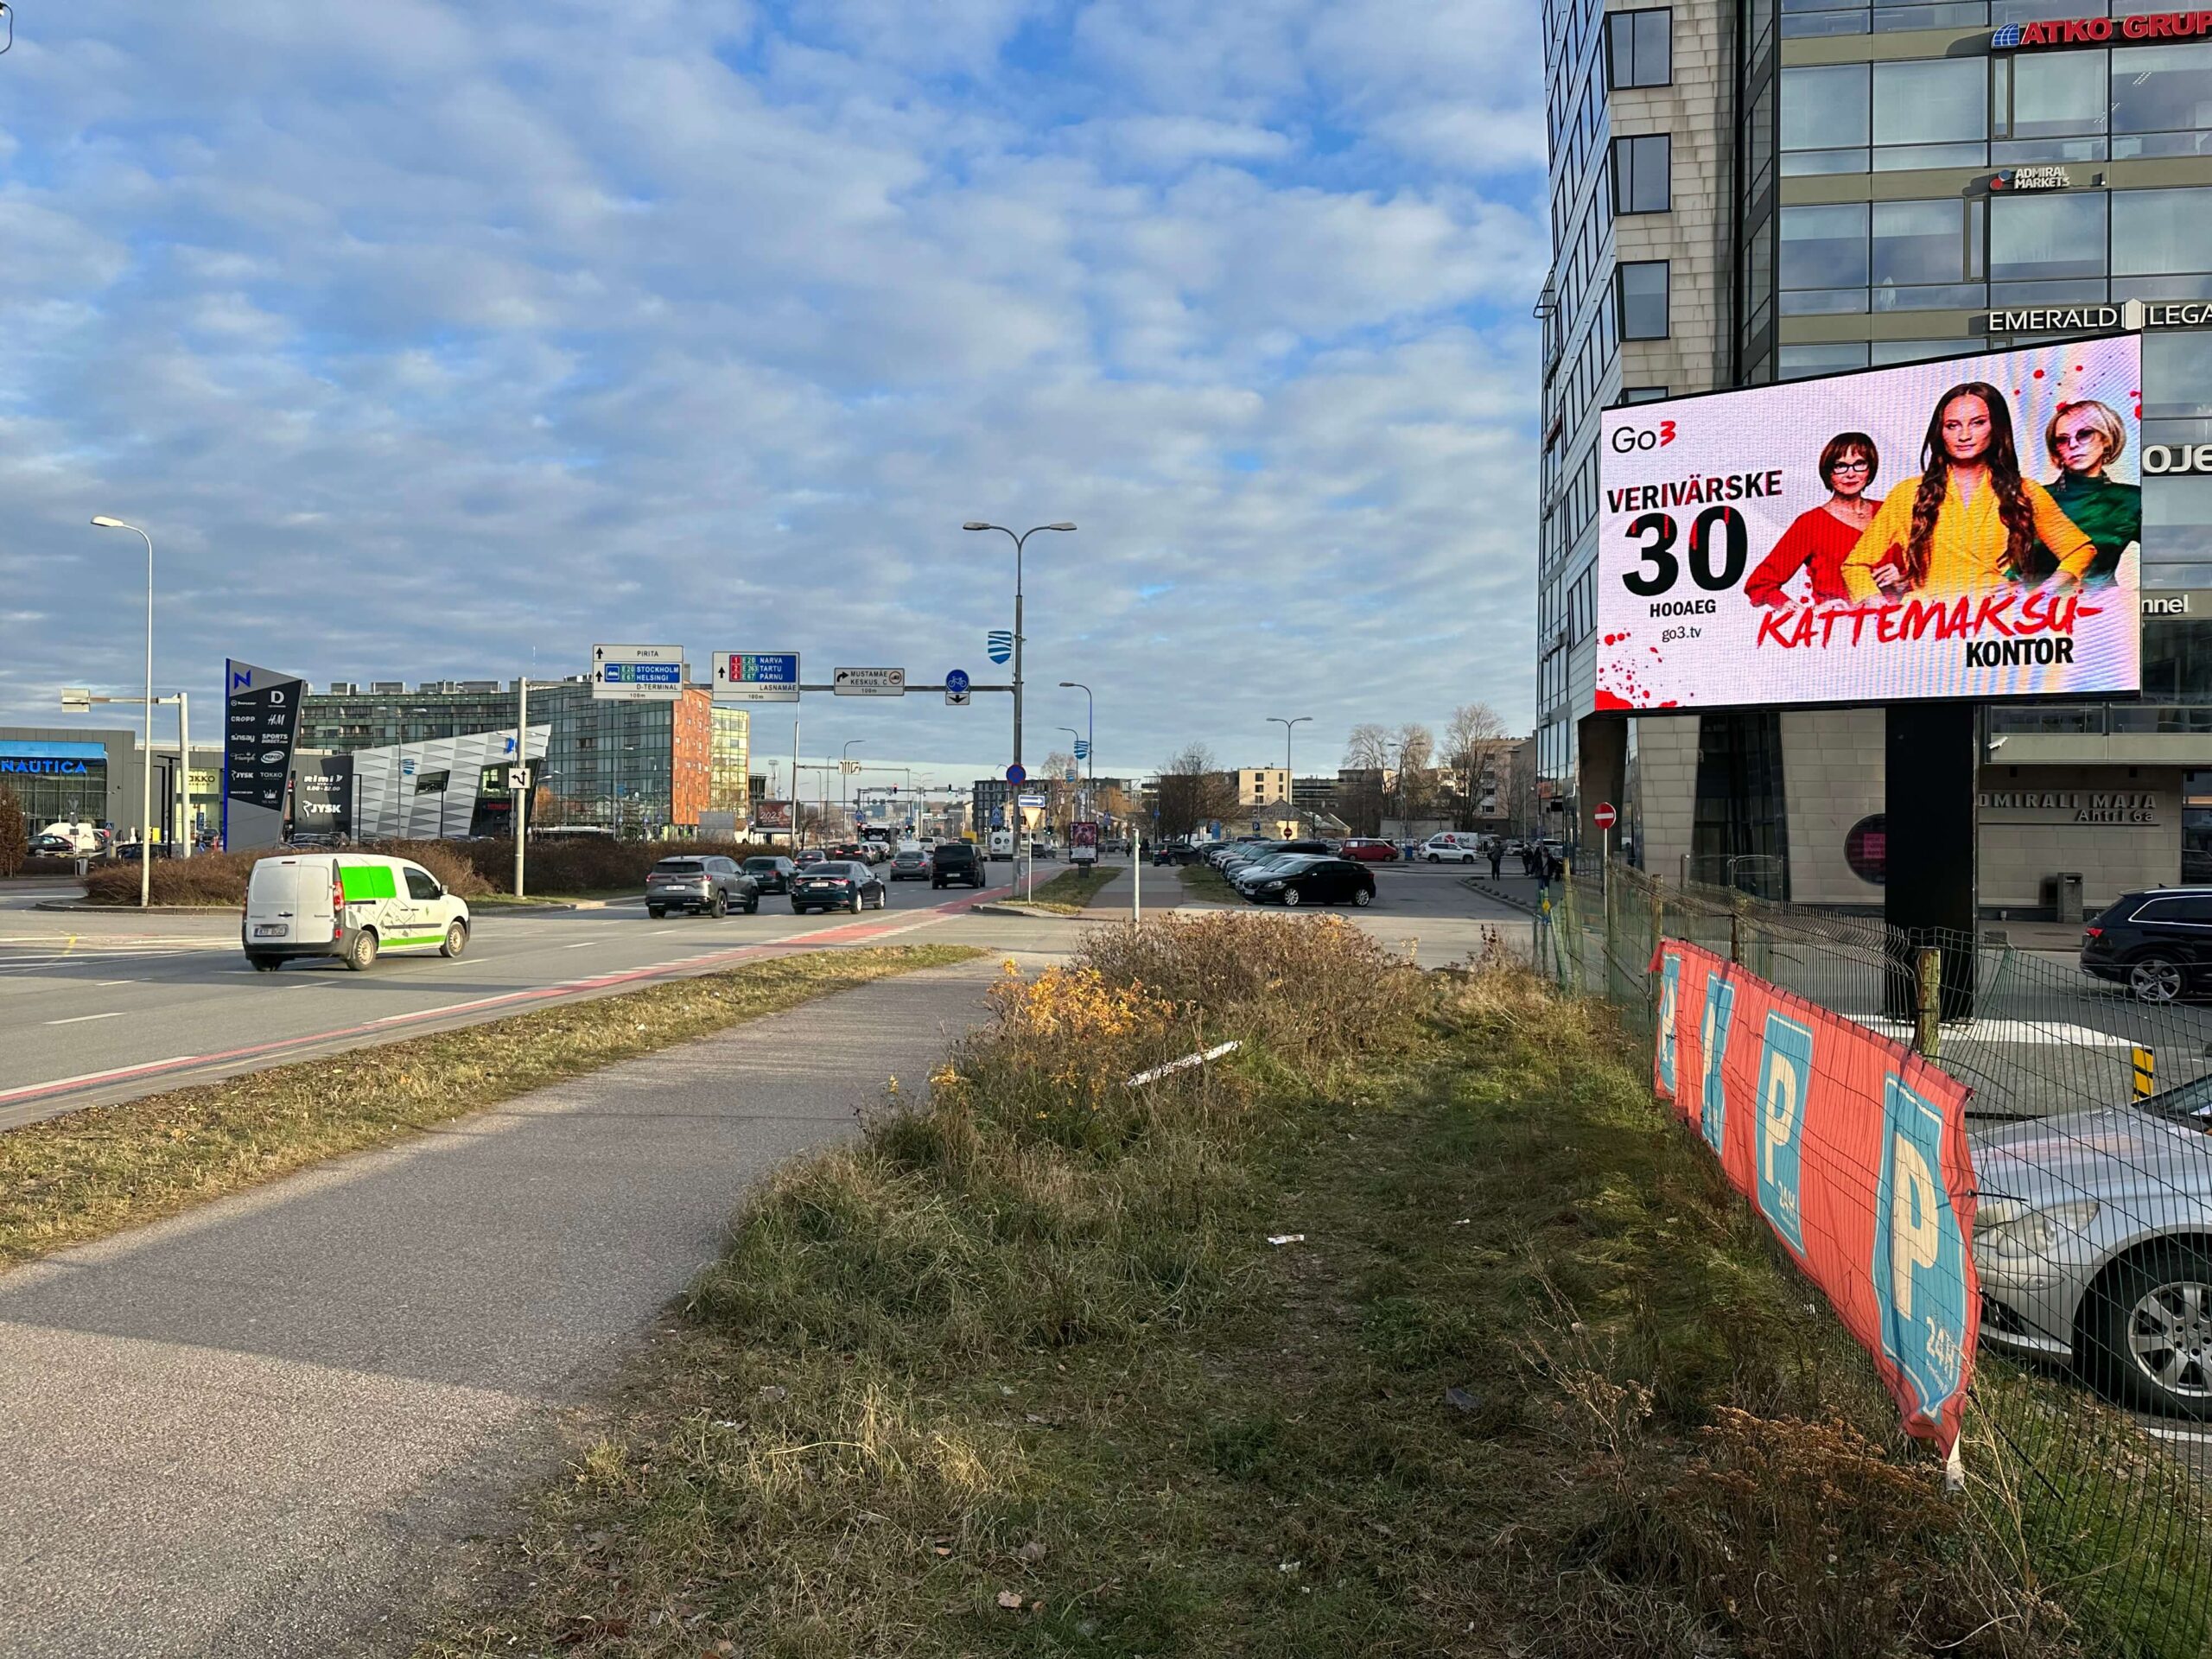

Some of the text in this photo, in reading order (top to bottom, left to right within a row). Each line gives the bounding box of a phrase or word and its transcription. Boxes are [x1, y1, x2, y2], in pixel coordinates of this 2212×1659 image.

[2019, 10, 2212, 45] ATKO GRUP
[2013, 175, 2070, 189] MARKETS
[2014, 166, 2067, 180] ADMIRAL
[1989, 307, 2118, 331] EMERALD
[1611, 420, 1676, 454] Go3
[1606, 469, 1783, 514] VERIVÄRSKE
[1622, 505, 1748, 597] 30
[1649, 599, 1717, 618] HOOAEG
[1662, 626, 1702, 643] go3.tv
[1966, 637, 2074, 668] KONTOR
[1, 760, 86, 773] NAUTICA
[311, 804, 341, 813] JYSK
[1978, 793, 2157, 809] DMIRALI MAJA
[2077, 810, 2154, 822] Ahtri 6a
[1764, 1051, 1797, 1188] P
[1777, 1180, 1796, 1221] 24H
[1891, 1131, 1939, 1321] P
